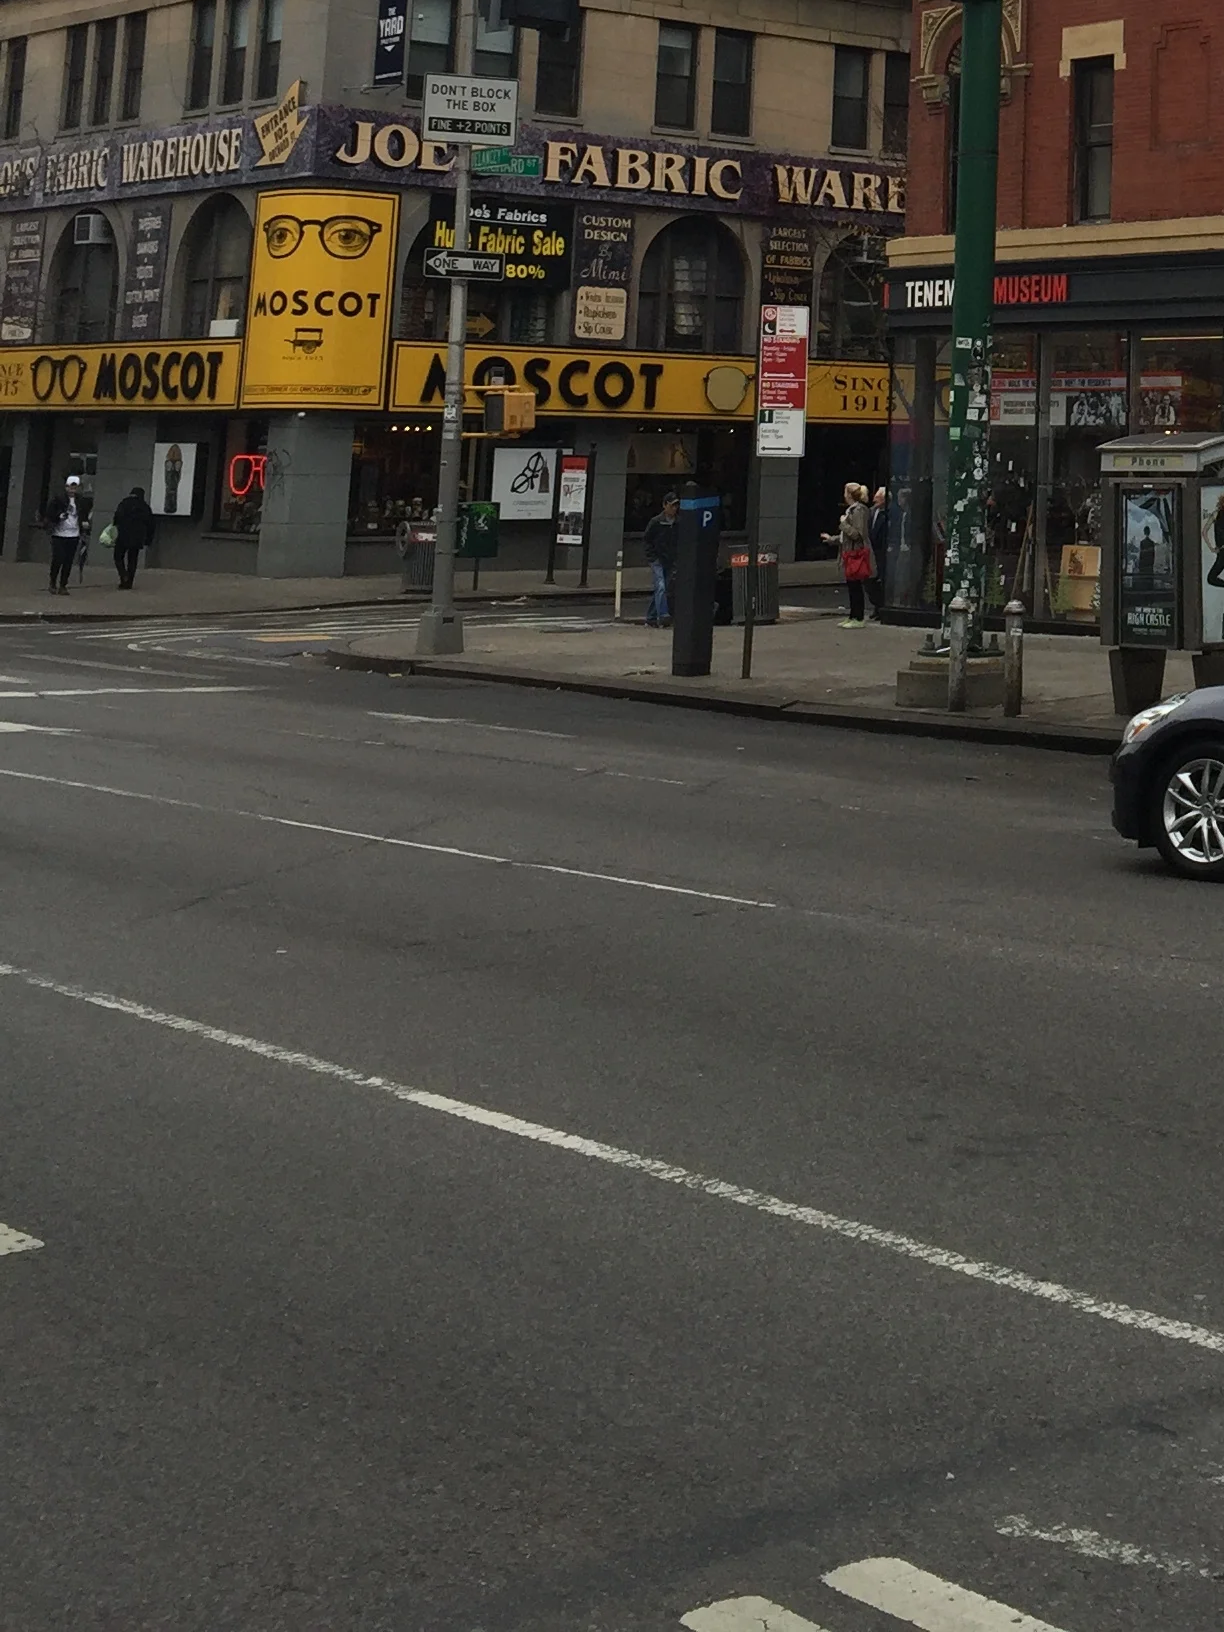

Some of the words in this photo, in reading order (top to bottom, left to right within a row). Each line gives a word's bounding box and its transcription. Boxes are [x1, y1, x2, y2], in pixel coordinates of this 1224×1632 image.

[379, 16, 404, 37] YARD
[431, 84, 467, 97] DON'T
[471, 87, 512, 100] BLOCK
[446, 99, 468, 111] THE
[473, 101, 496, 113] BOX
[261, 96, 297, 140] ENTRANCE
[431, 119, 452, 131] FINE
[456, 121, 472, 131] +2
[474, 123, 508, 135] POINTS
[0, 157, 35, 197] OE'S
[122, 128, 243, 184] WAREHOUSE
[543, 140, 743, 201] FABRIC
[772, 163, 906, 214] WARE
[469, 204, 491, 219] e's
[497, 208, 548, 224] Fabrics
[582, 215, 631, 229] CUSTOM
[478, 225, 525, 256] Fabric
[532, 230, 565, 256] Sale
[584, 229, 628, 242] DESIGN
[770, 227, 807, 239] LARGEST
[769, 240, 809, 252] SELECTION
[433, 257, 459, 269] ONE
[472, 259, 497, 272] WAY
[766, 254, 777, 264] OF
[780, 255, 811, 266] FABRICS
[506, 263, 545, 280] 80%
[580, 257, 630, 282] Mimi
[905, 279, 955, 308] TENEM
[993, 274, 1068, 305] MUSEUM
[254, 289, 381, 319] MOSCOT
[93, 351, 224, 401] MOSCOT
[420, 353, 665, 410] MOSCOT
[834, 374, 892, 392] SINC
[840, 395, 897, 412] 1915
[1131, 457, 1166, 467] Phone
[702, 510, 713, 528] P
